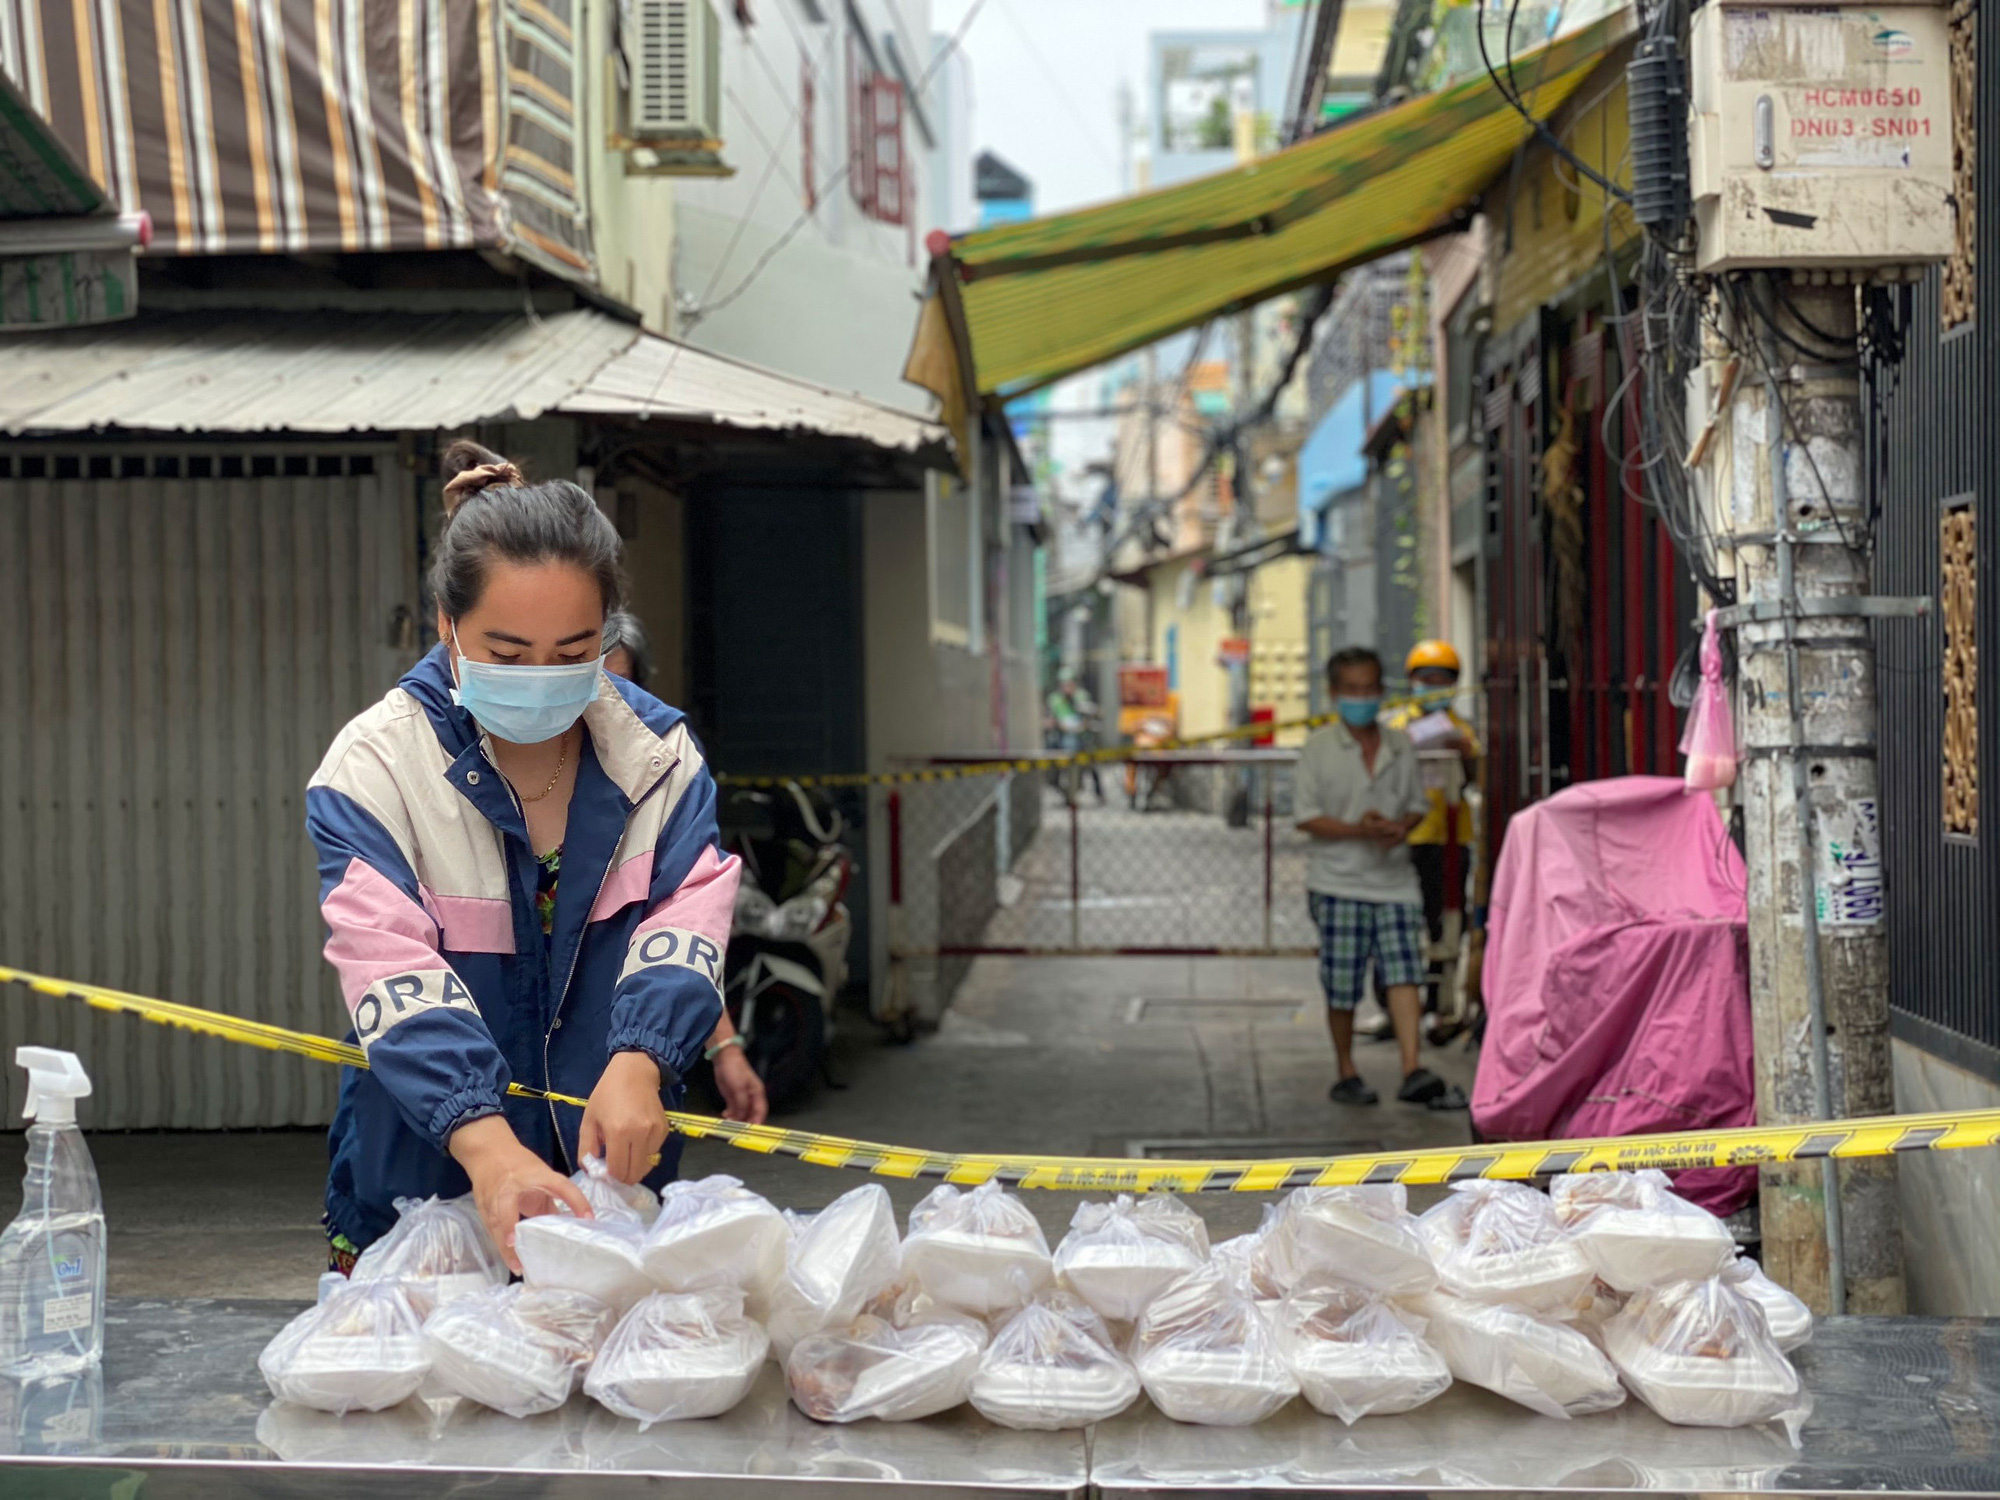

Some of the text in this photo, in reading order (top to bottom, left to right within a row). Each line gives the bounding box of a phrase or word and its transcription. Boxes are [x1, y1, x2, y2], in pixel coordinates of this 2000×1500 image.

[1804, 86, 1922, 107] HCM0650
[629, 930, 721, 989] OR
[355, 971, 477, 1038] ORA
